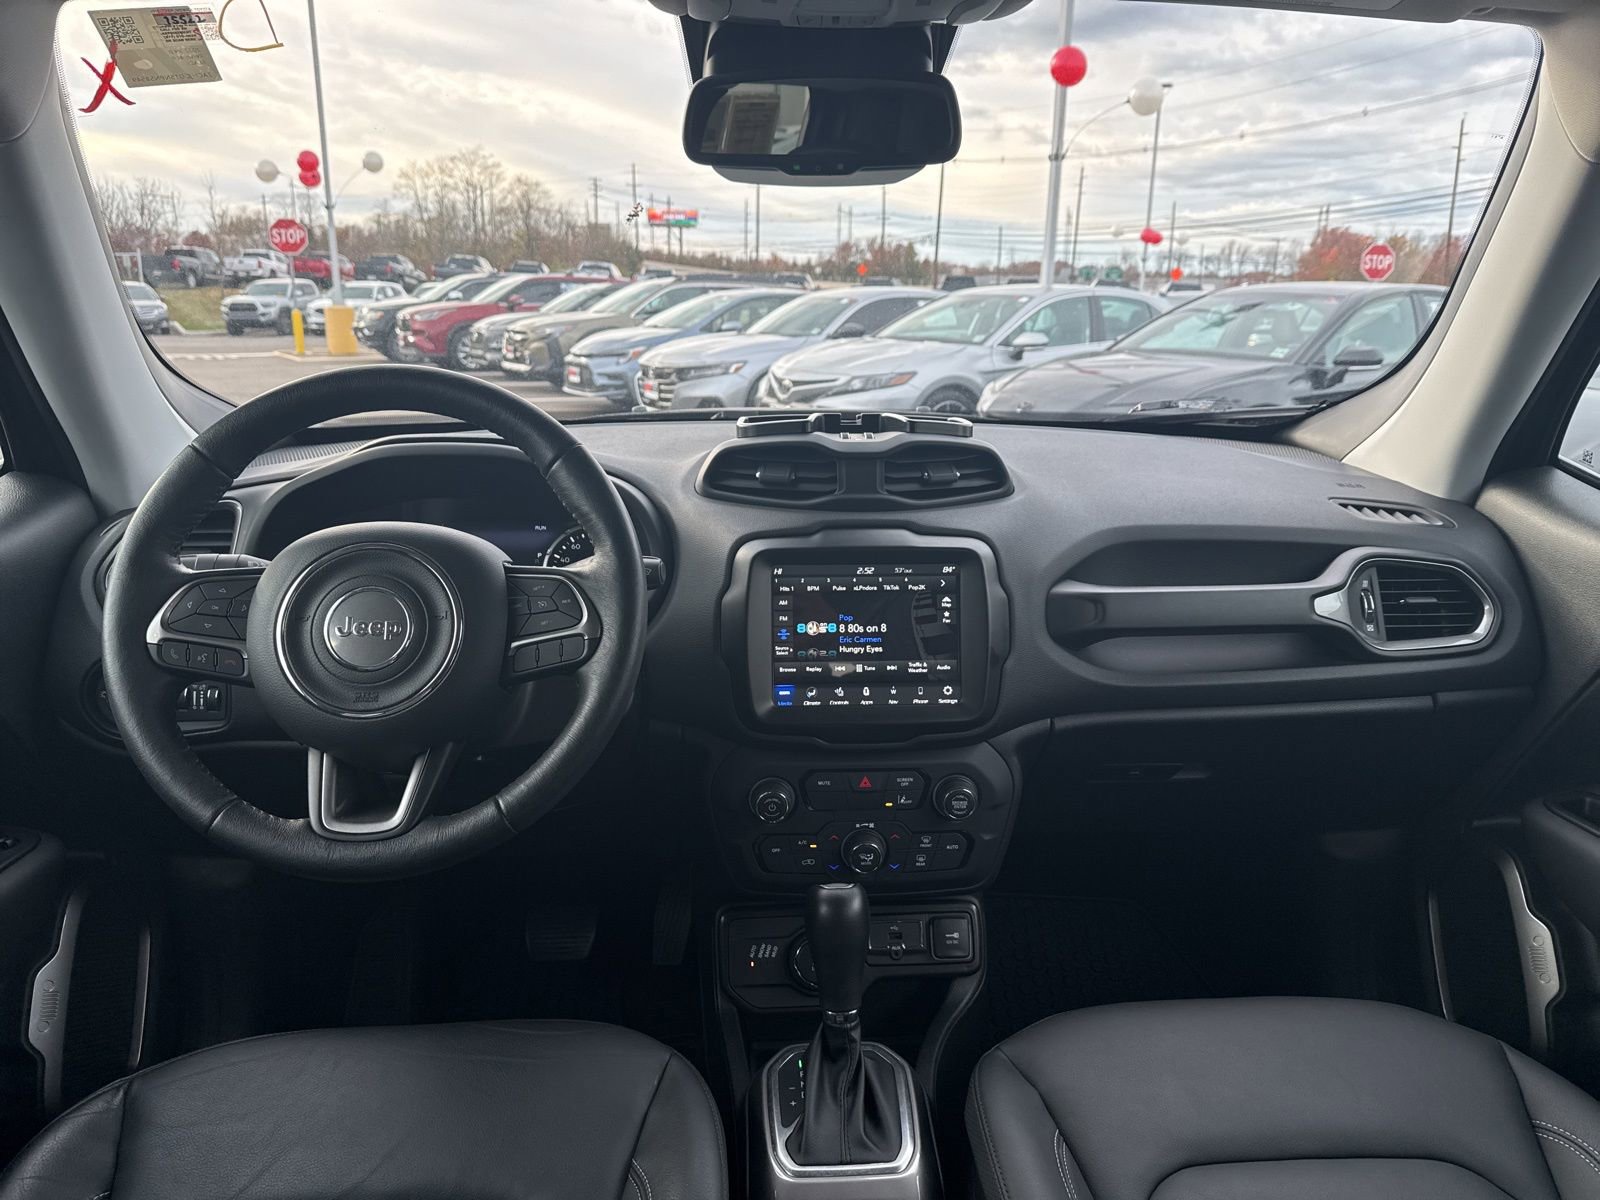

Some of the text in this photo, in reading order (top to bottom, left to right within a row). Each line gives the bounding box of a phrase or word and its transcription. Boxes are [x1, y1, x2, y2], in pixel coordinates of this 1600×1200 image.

[271, 228, 305, 244] STOP
[1364, 254, 1393, 270] STOP
[856, 566, 875, 575] 2:52
[839, 614, 854, 622] Pop
[334, 616, 402, 641] Jeep
[839, 623, 846, 633] 8
[847, 623, 864, 633] 80s
[880, 623, 887, 632] 8
[839, 635, 882, 643] Eric Carmen
[839, 645, 883, 654] Hungry Eyes
